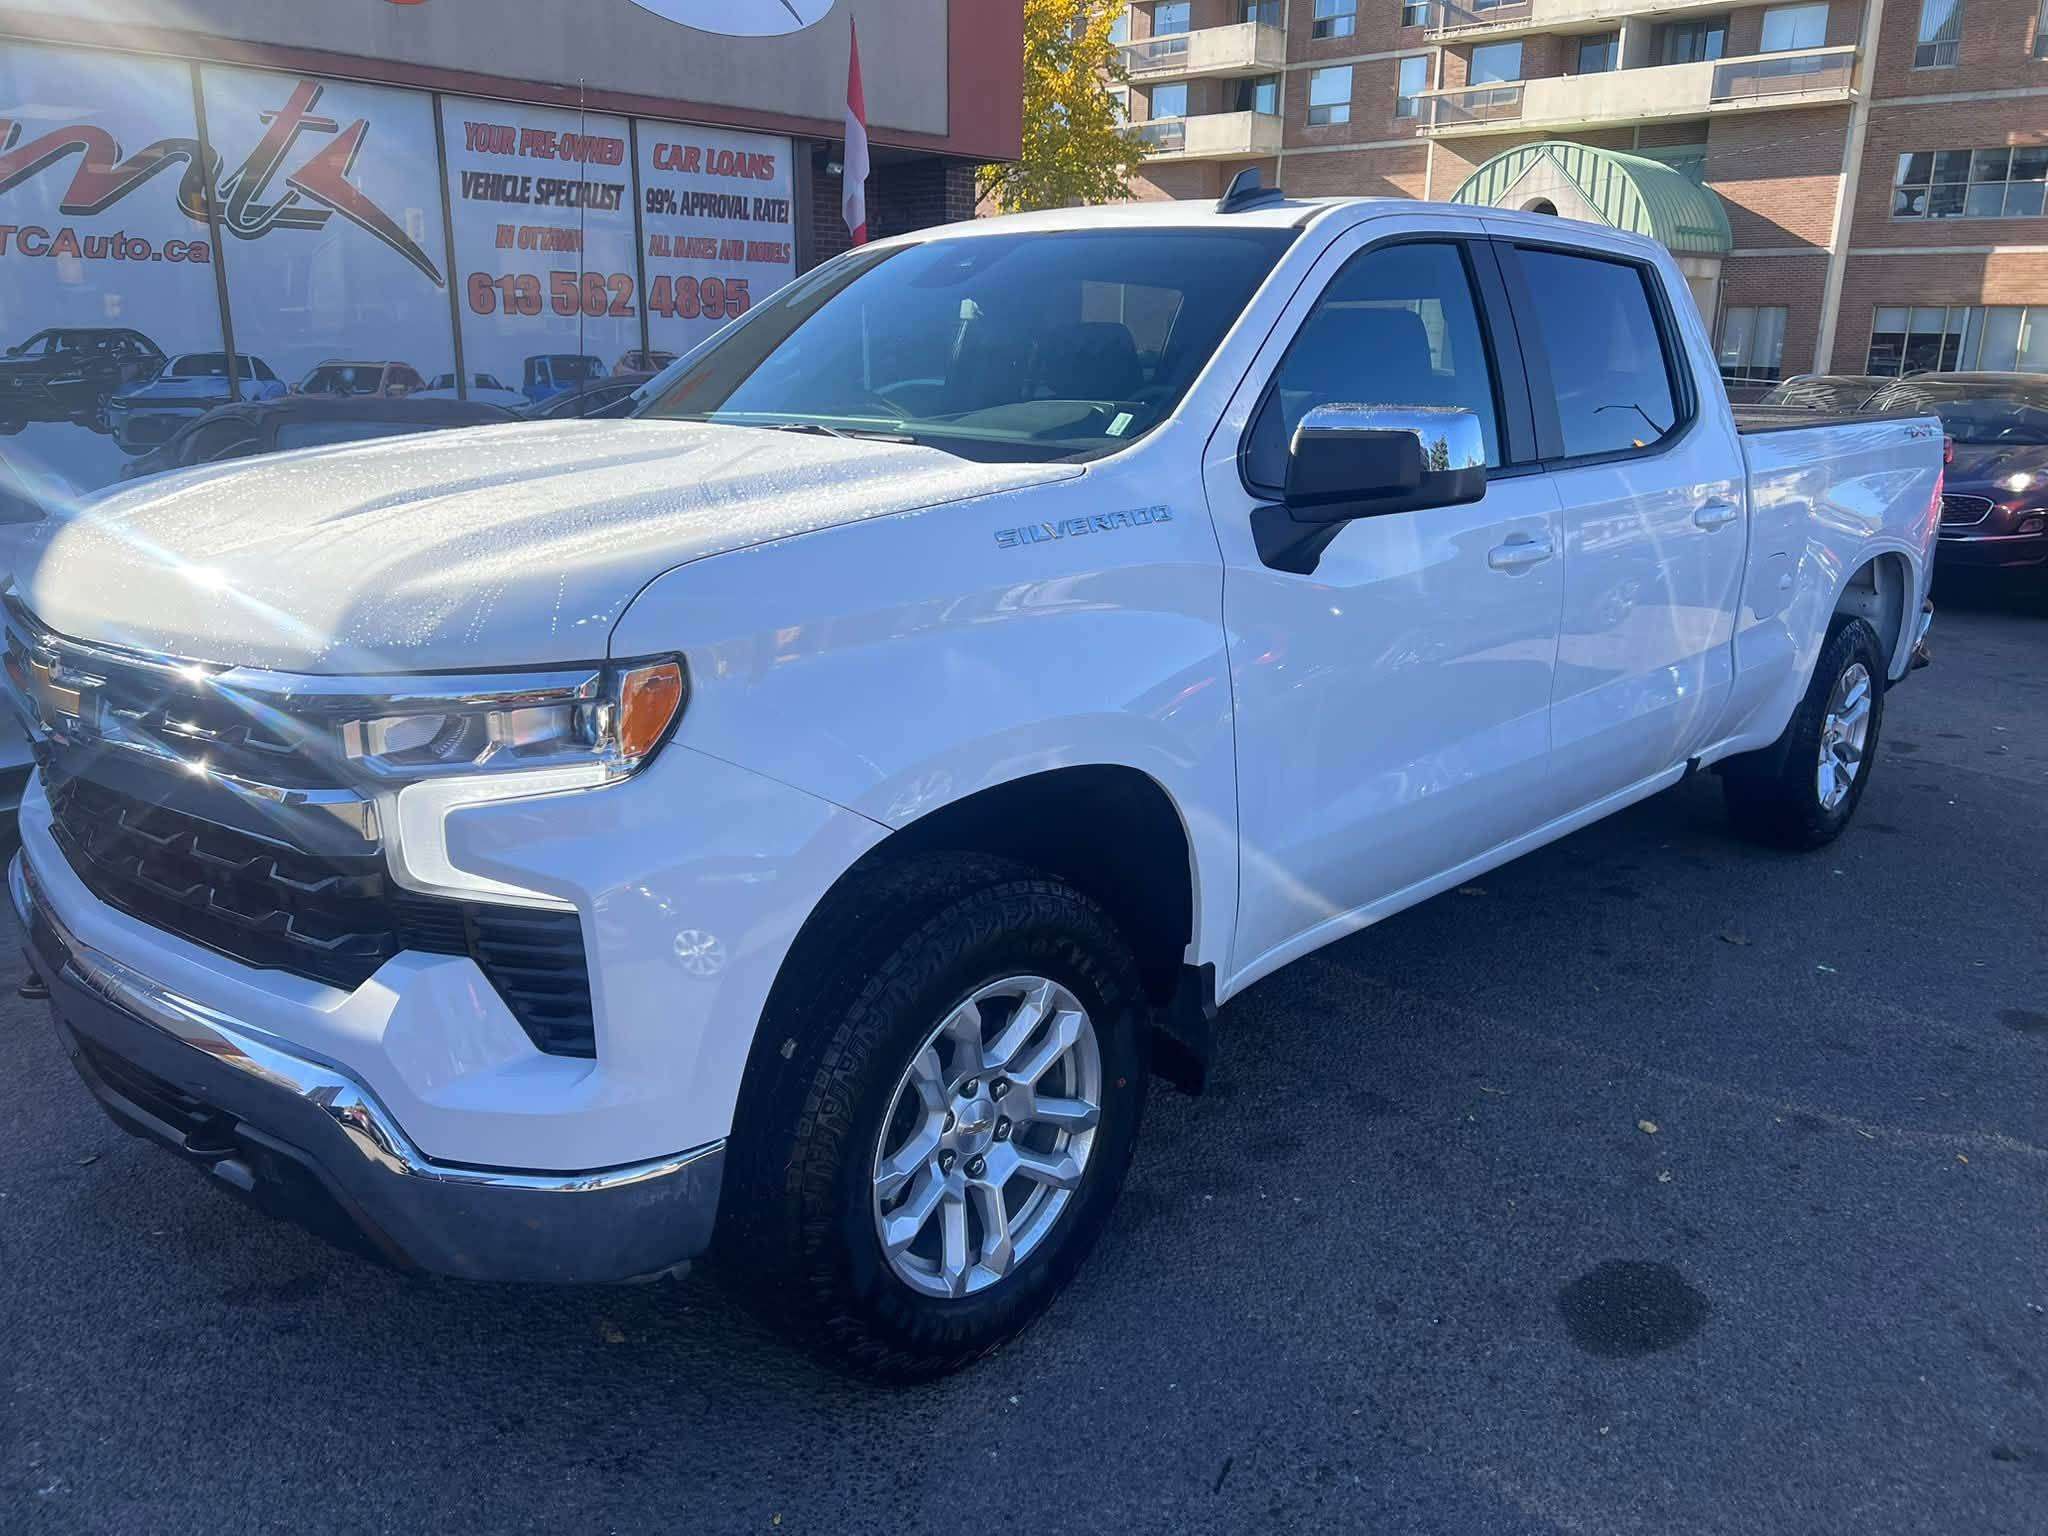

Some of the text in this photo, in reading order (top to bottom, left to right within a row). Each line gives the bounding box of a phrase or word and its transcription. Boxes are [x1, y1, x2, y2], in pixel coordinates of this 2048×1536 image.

[464, 121, 624, 166] YOUR PRE-OWNED
[653, 143, 775, 181] CAR LOANS
[461, 170, 625, 210] VEHICLE SPECIALIST
[646, 187, 790, 223] 99% APPROVAL RATE!
[648, 234, 792, 264] ALL MAKES AND MODELS
[467, 270, 750, 320] 613 562 4895
[994, 504, 1174, 549] SILVERADO
